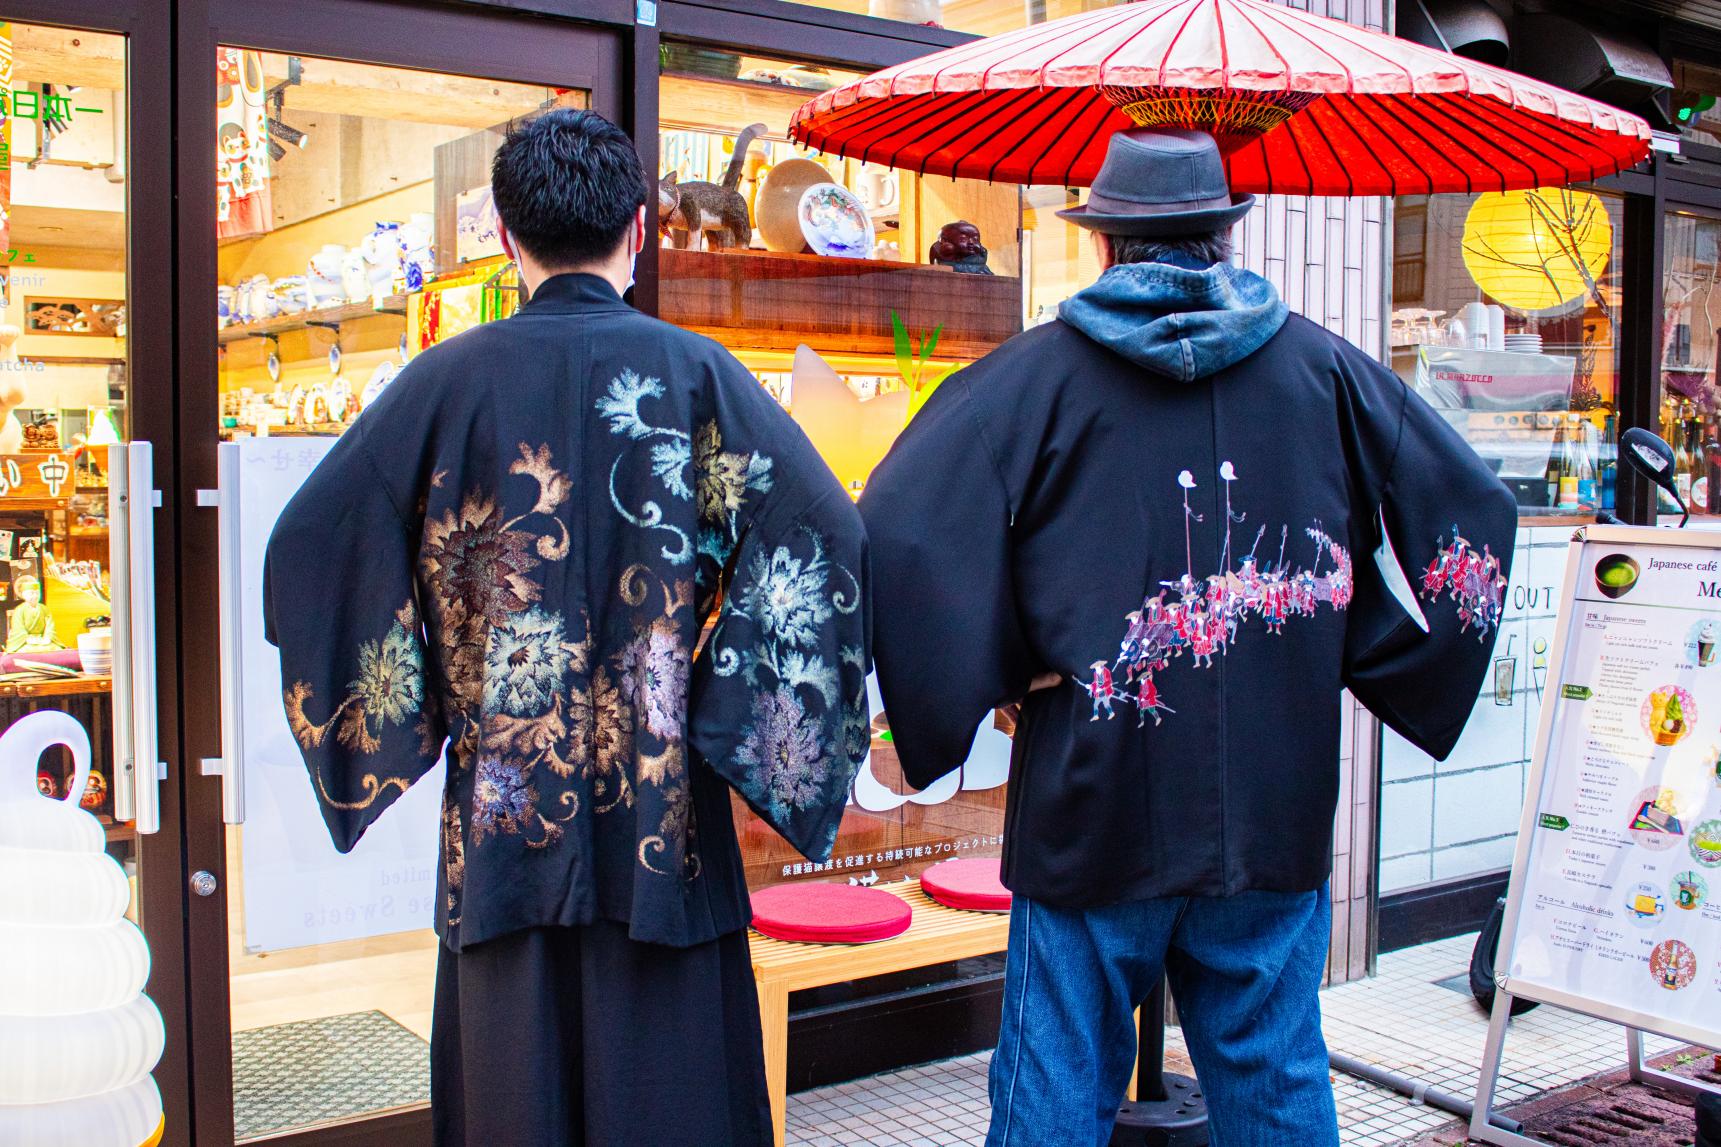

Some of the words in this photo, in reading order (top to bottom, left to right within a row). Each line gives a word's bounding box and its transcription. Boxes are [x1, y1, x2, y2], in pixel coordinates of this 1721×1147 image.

[0, 89, 104, 122] 日本一
[1648, 558, 1693, 573] Japanese
[1696, 560, 1718, 572] café
[1513, 585, 1555, 611] OUT
